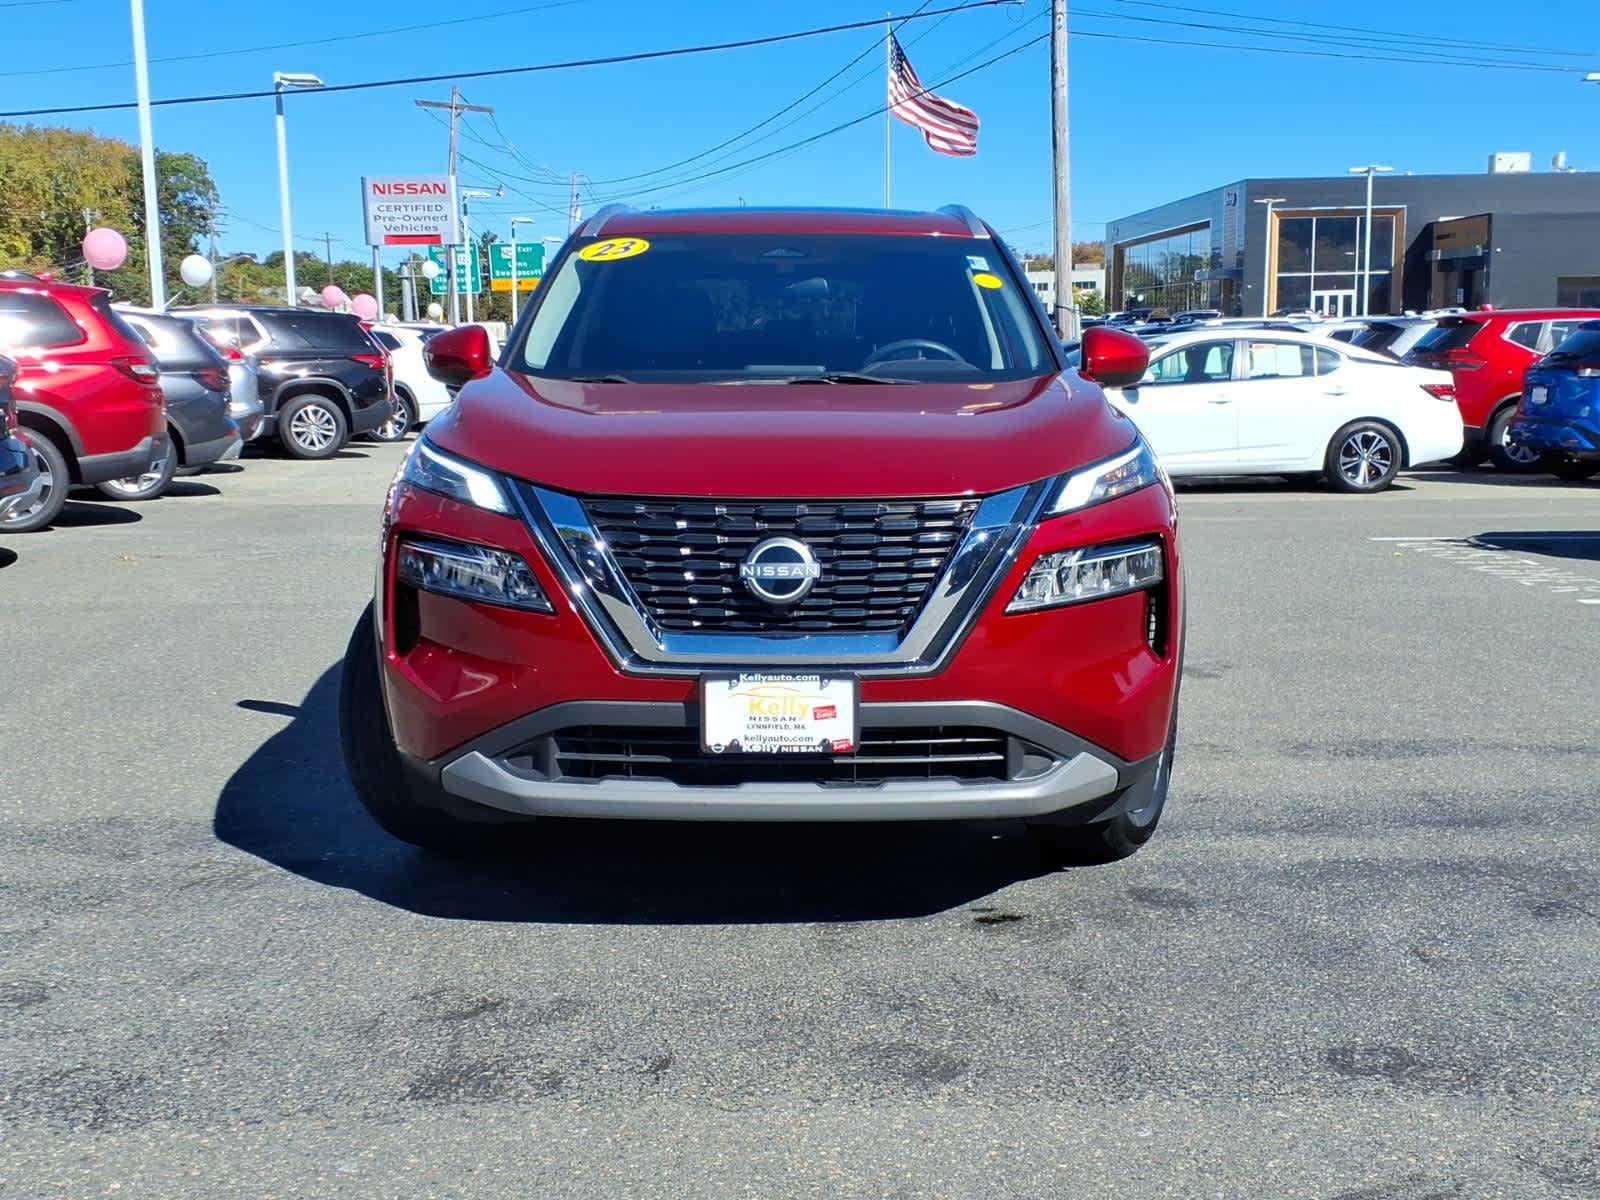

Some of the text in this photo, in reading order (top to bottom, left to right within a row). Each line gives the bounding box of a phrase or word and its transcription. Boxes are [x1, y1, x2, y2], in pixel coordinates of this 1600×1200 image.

[372, 183, 447, 195] NISSAN
[376, 204, 444, 213] CERTIFIED
[374, 214, 448, 222] Pre-Owned
[383, 224, 439, 232] Vehicles
[590, 240, 637, 257] 23
[742, 566, 819, 577] NISSAN
[739, 673, 820, 684] Kellyauto.com
[748, 698, 809, 720] Kelly
[743, 734, 814, 743] kellyauto.com
[742, 744, 779, 753] Kelly
[780, 745, 823, 753] NISSAN
